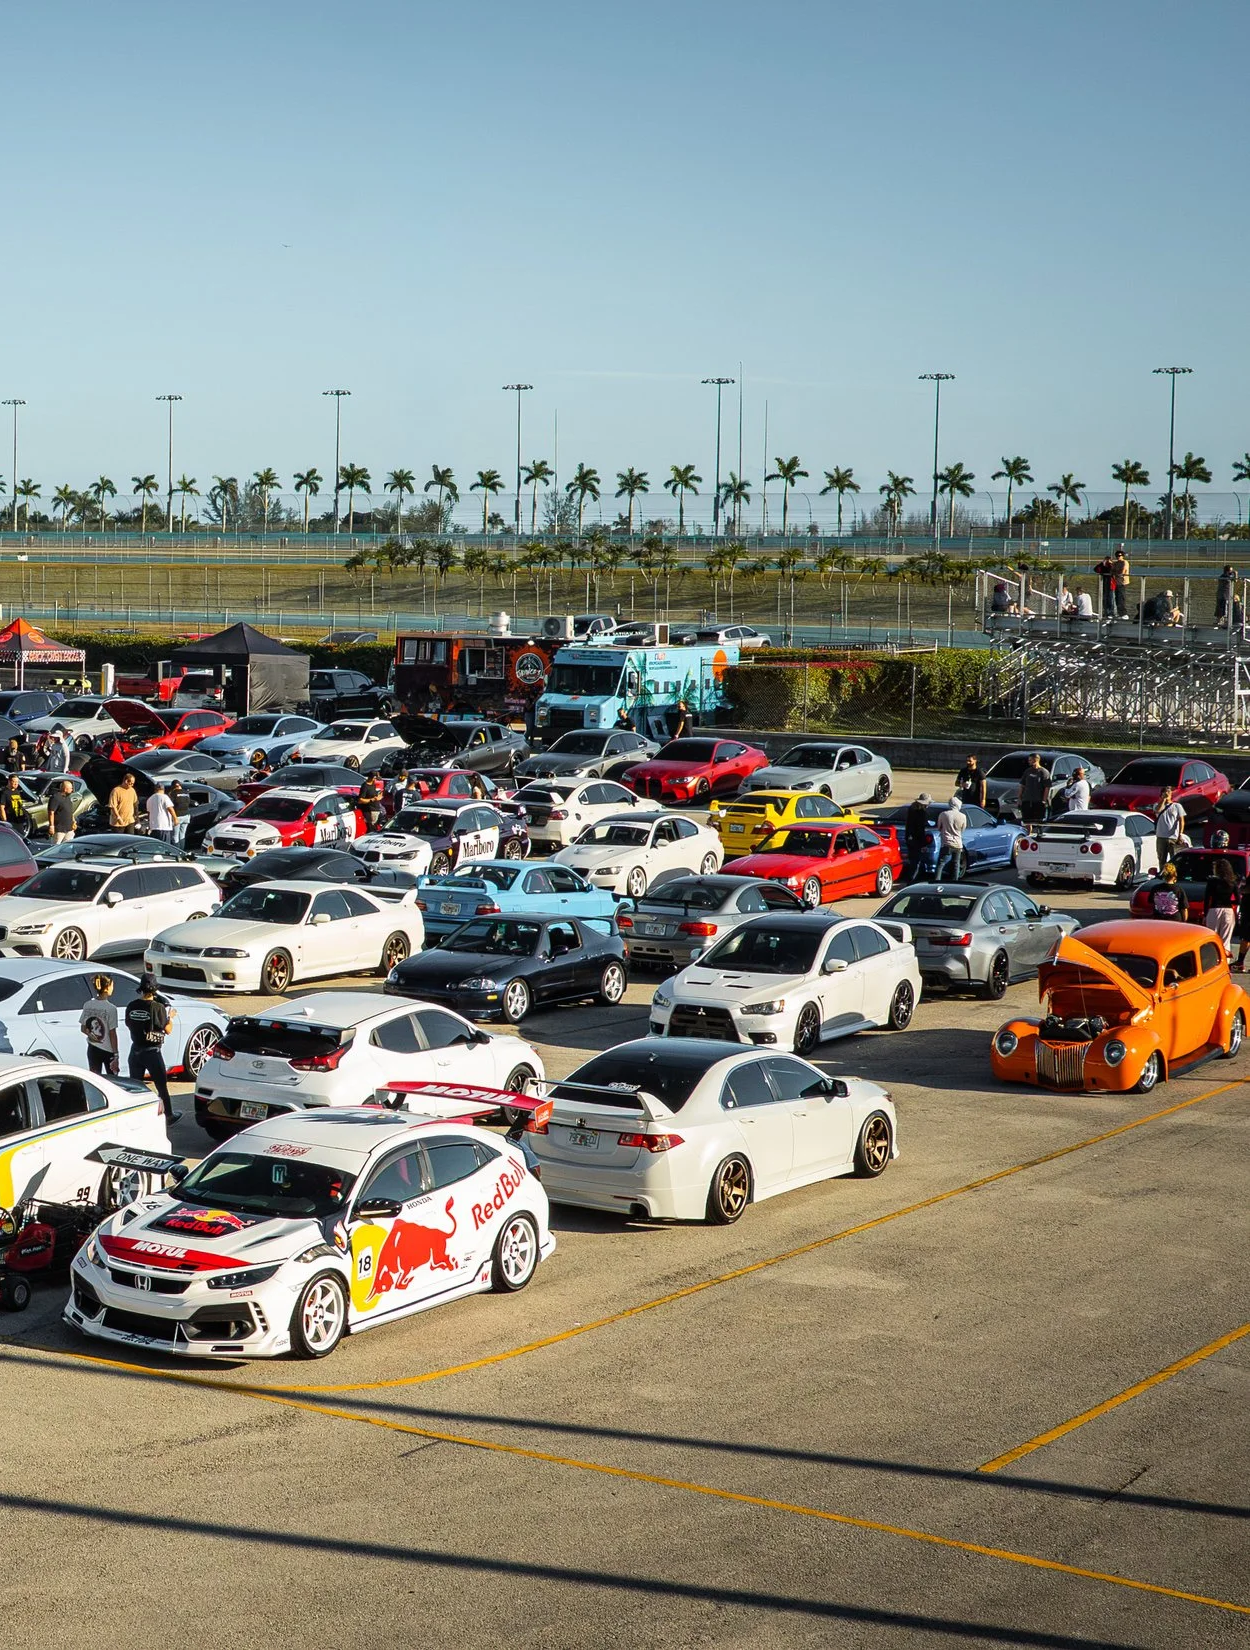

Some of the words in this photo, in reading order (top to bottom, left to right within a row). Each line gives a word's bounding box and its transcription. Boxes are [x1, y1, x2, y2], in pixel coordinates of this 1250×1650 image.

[320, 824, 353, 844] Marlboro
[365, 838, 407, 848] Marlboro
[462, 839, 495, 858] Marlboro
[418, 1084, 518, 1105] MOTUL
[116, 1152, 141, 1164] ONE
[141, 1158, 166, 1169] WAY
[77, 1186, 90, 1201] 99
[471, 1183, 505, 1231] Red
[499, 1156, 526, 1199] Bull
[407, 1196, 432, 1210] HONDA
[131, 1241, 188, 1258] MOTUL
[358, 1255, 372, 1273] 18
